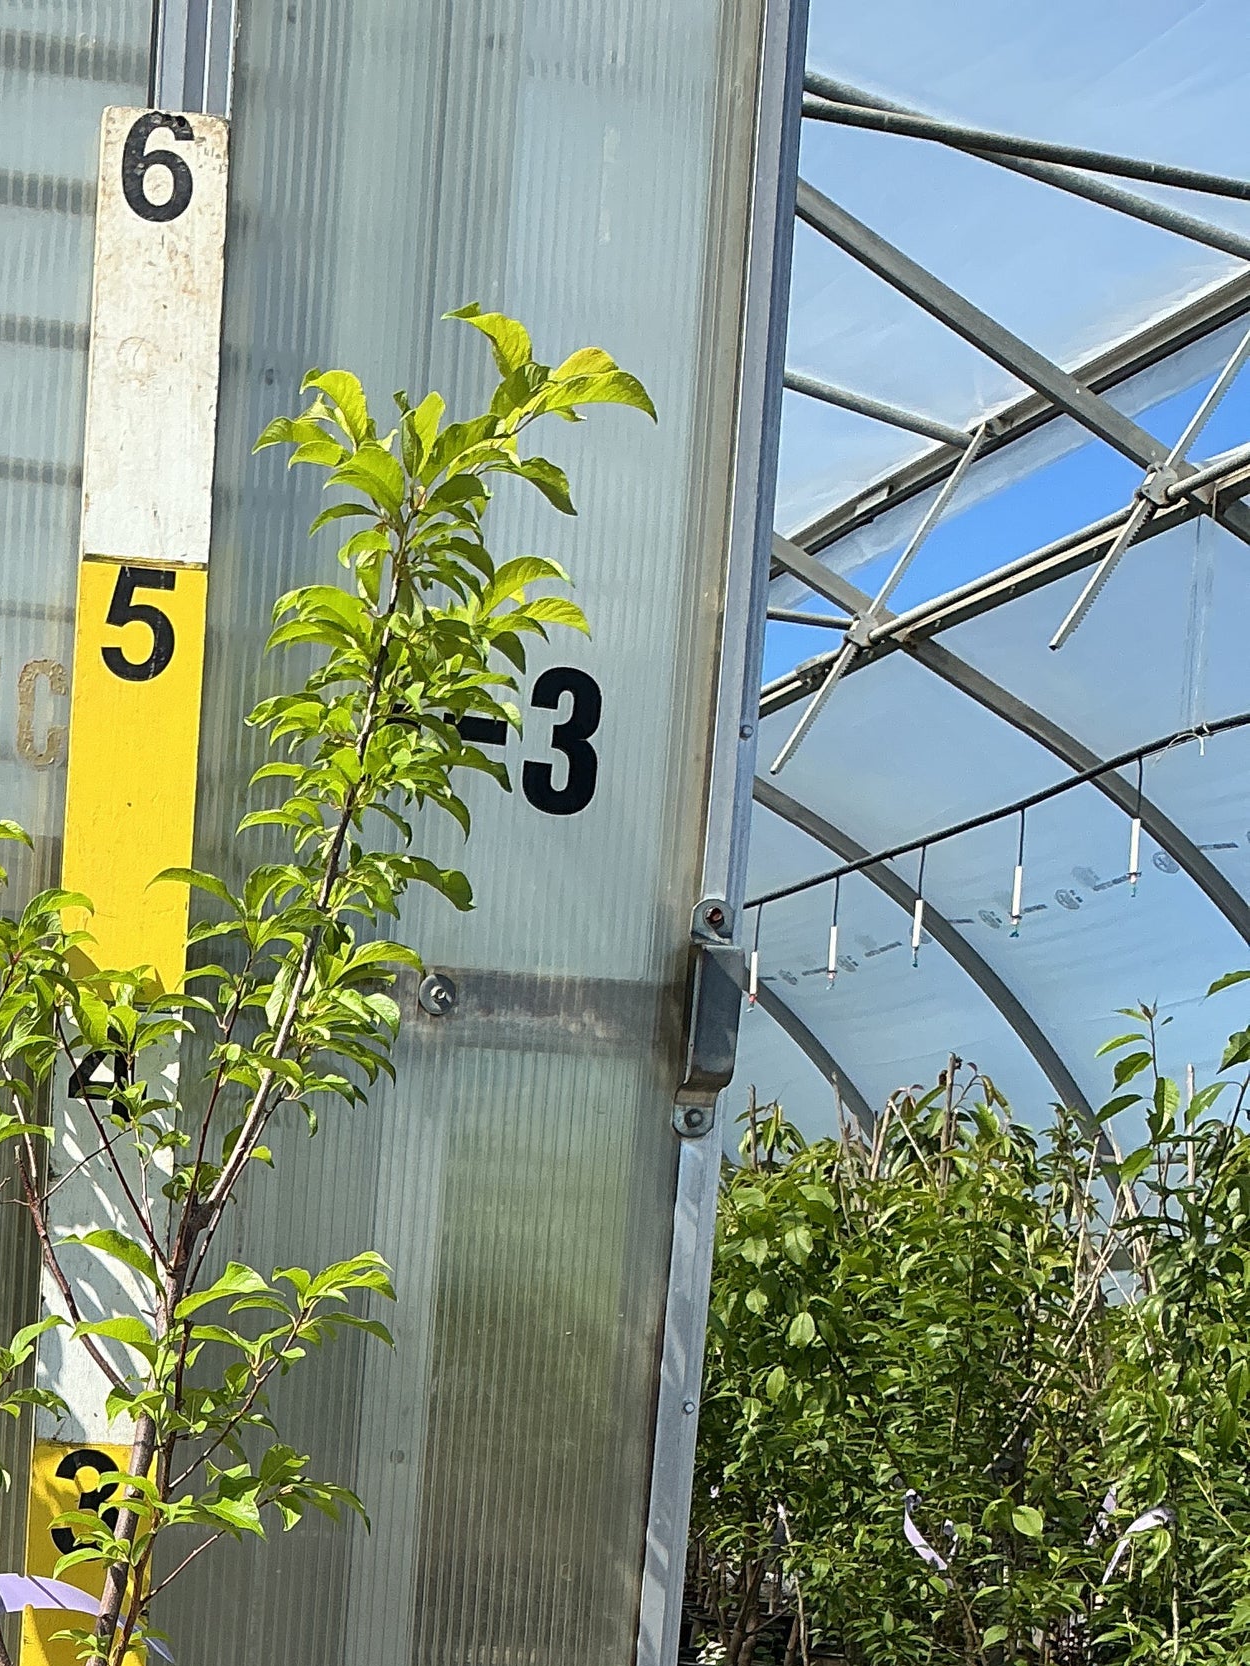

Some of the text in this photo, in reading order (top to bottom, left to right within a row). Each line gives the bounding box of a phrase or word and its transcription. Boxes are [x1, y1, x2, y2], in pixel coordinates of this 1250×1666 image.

[122, 111, 194, 222] 6
[101, 566, 176, 681] 5
[382, 652, 602, 816] -3
[68, 1022, 146, 1123] 4
[51, 1449, 121, 1562] 3
